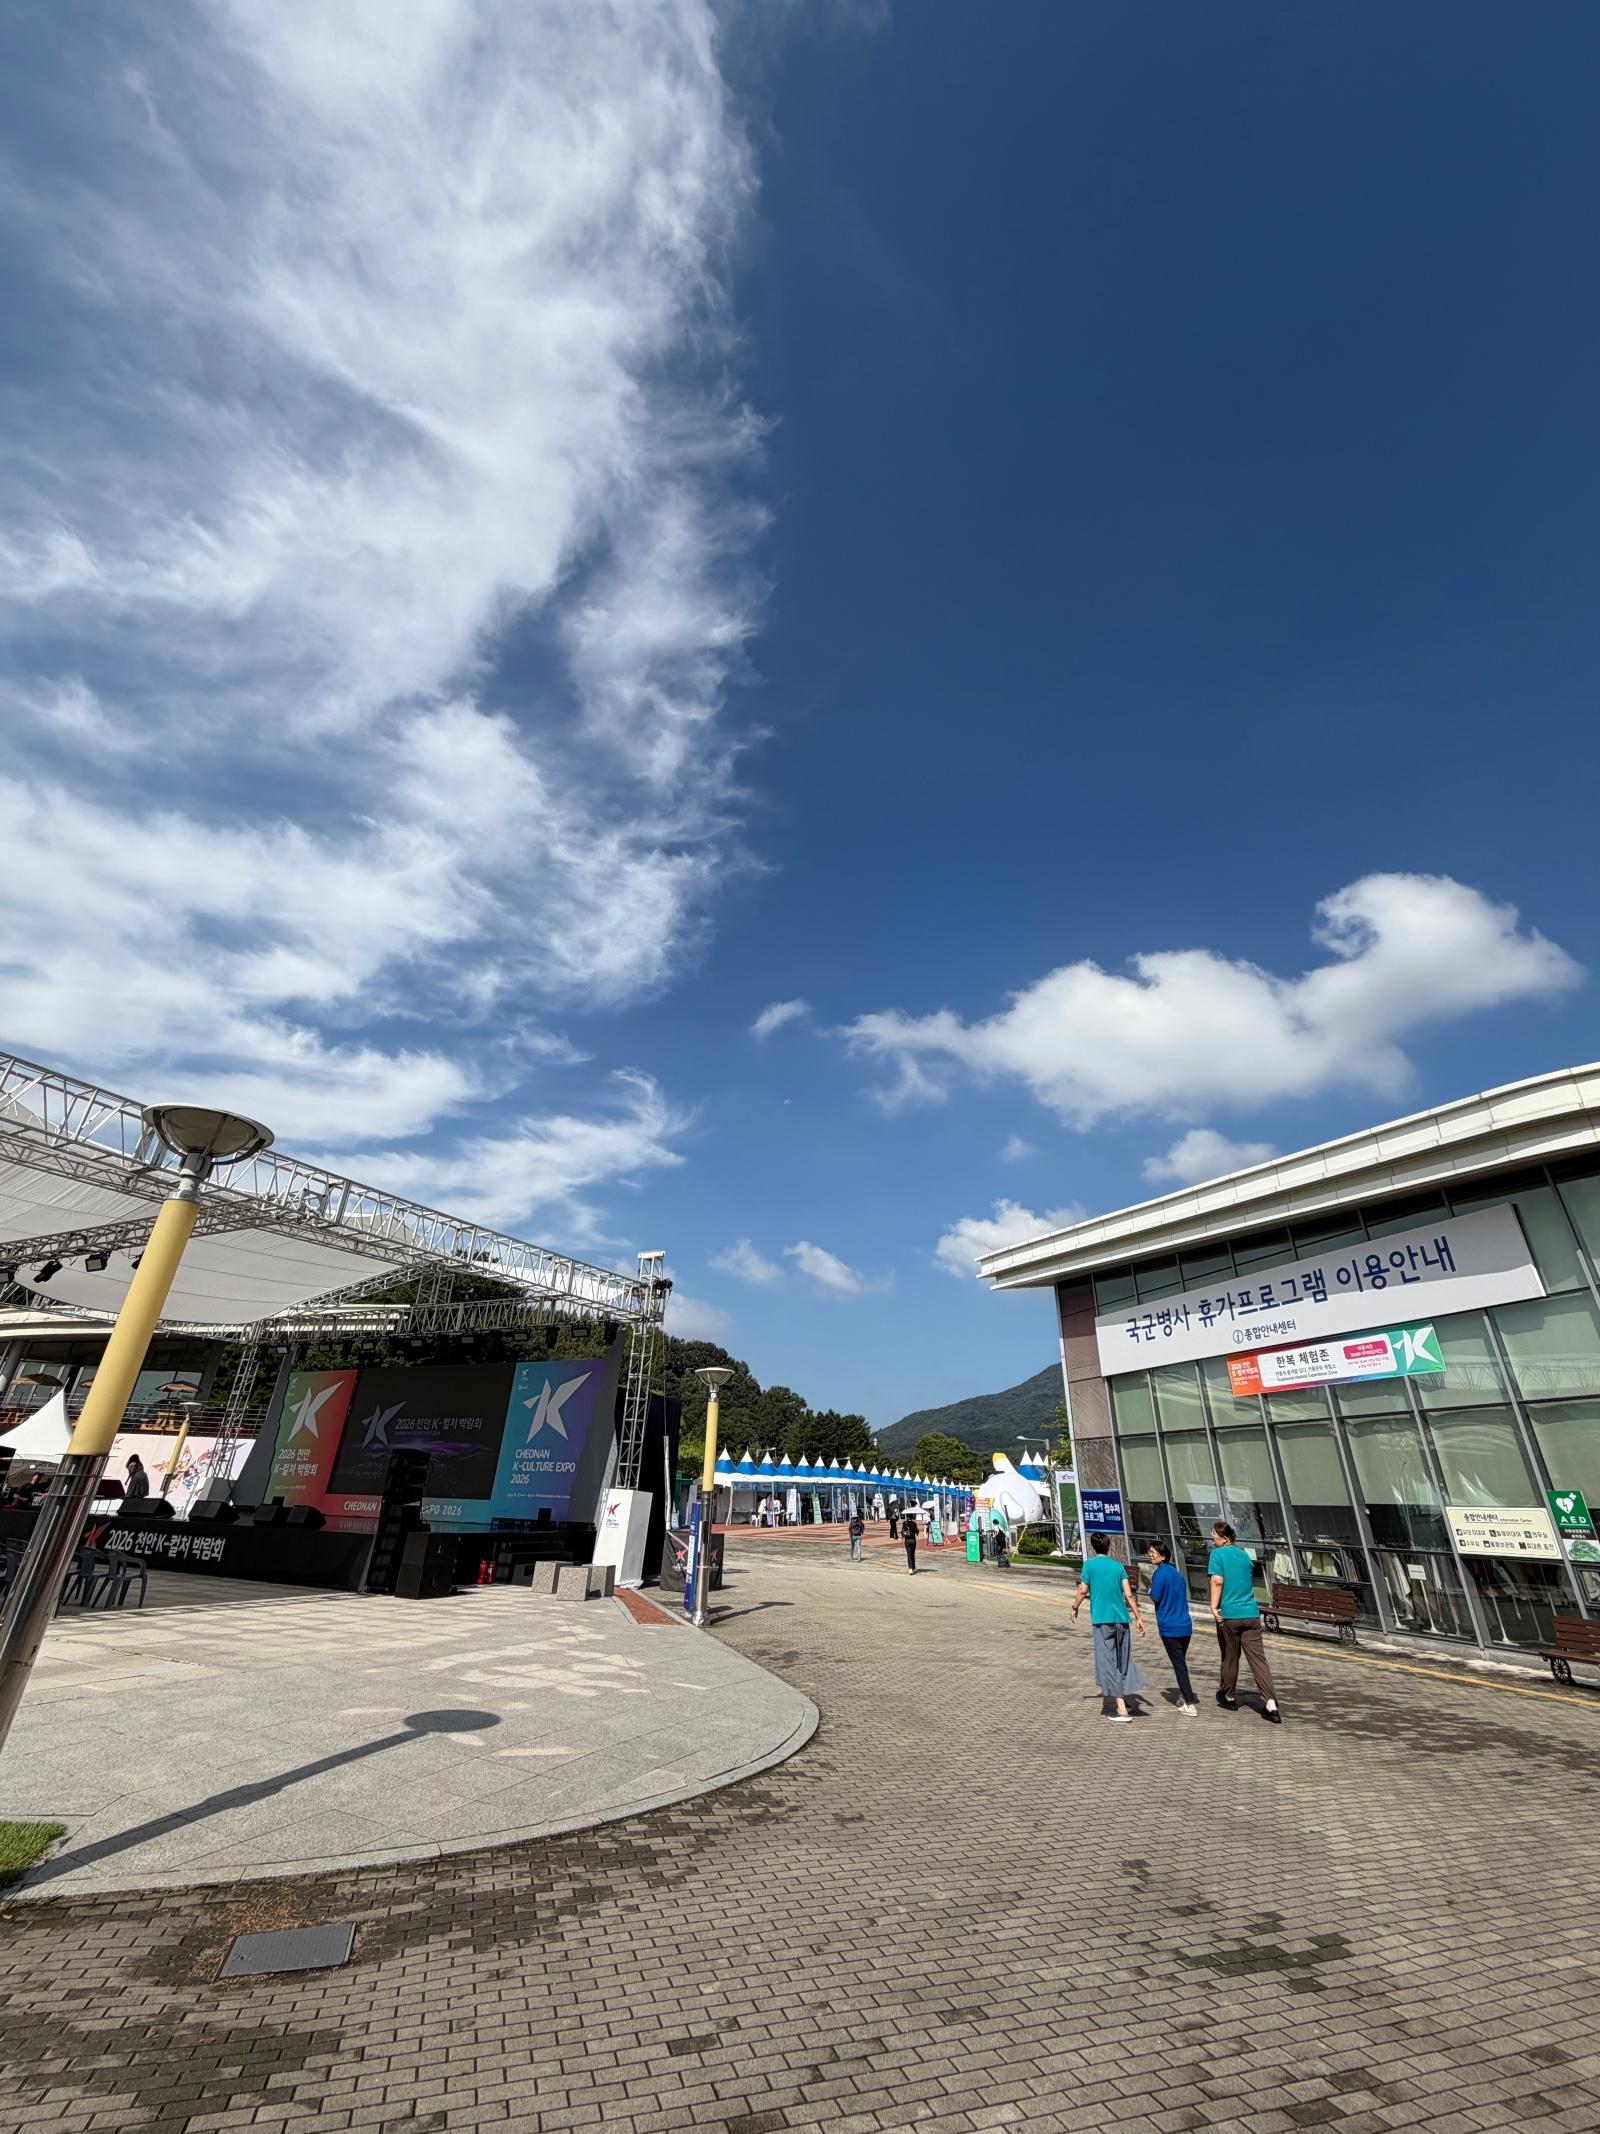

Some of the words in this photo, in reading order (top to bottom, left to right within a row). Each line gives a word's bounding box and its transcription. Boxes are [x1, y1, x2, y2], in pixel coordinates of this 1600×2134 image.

[1125, 1303, 1190, 1344] 국군병사
[1198, 1267, 1329, 1329] 휴가프로그램
[1336, 1235, 1456, 1293] 이용안내
[1244, 1319, 1297, 1341] 종합안내센터
[1275, 1354, 1296, 1368] 한복
[1298, 1348, 1330, 1365] 체험존
[395, 1418, 415, 1430] 2026
[278, 1448, 296, 1460] 2026
[515, 1448, 551, 1459] CHEONAN
[512, 1461, 555, 1472] K-CULTURE
[555, 1462, 576, 1473] EXPO
[510, 1473, 530, 1484] 2026
[343, 1500, 377, 1512] CHEONAN
[442, 1505, 462, 1516] 2026
[1083, 1500, 1104, 1511] 국군휴가
[1104, 1503, 1121, 1514] 접수처
[1084, 1512, 1105, 1523] 프로그램
[1560, 1516, 1587, 1524] AED
[104, 1529, 135, 1551] 2026
[134, 1531, 158, 1555] 천안
[155, 1533, 192, 1559] K-컬처
[192, 1536, 226, 1562] 박람회
